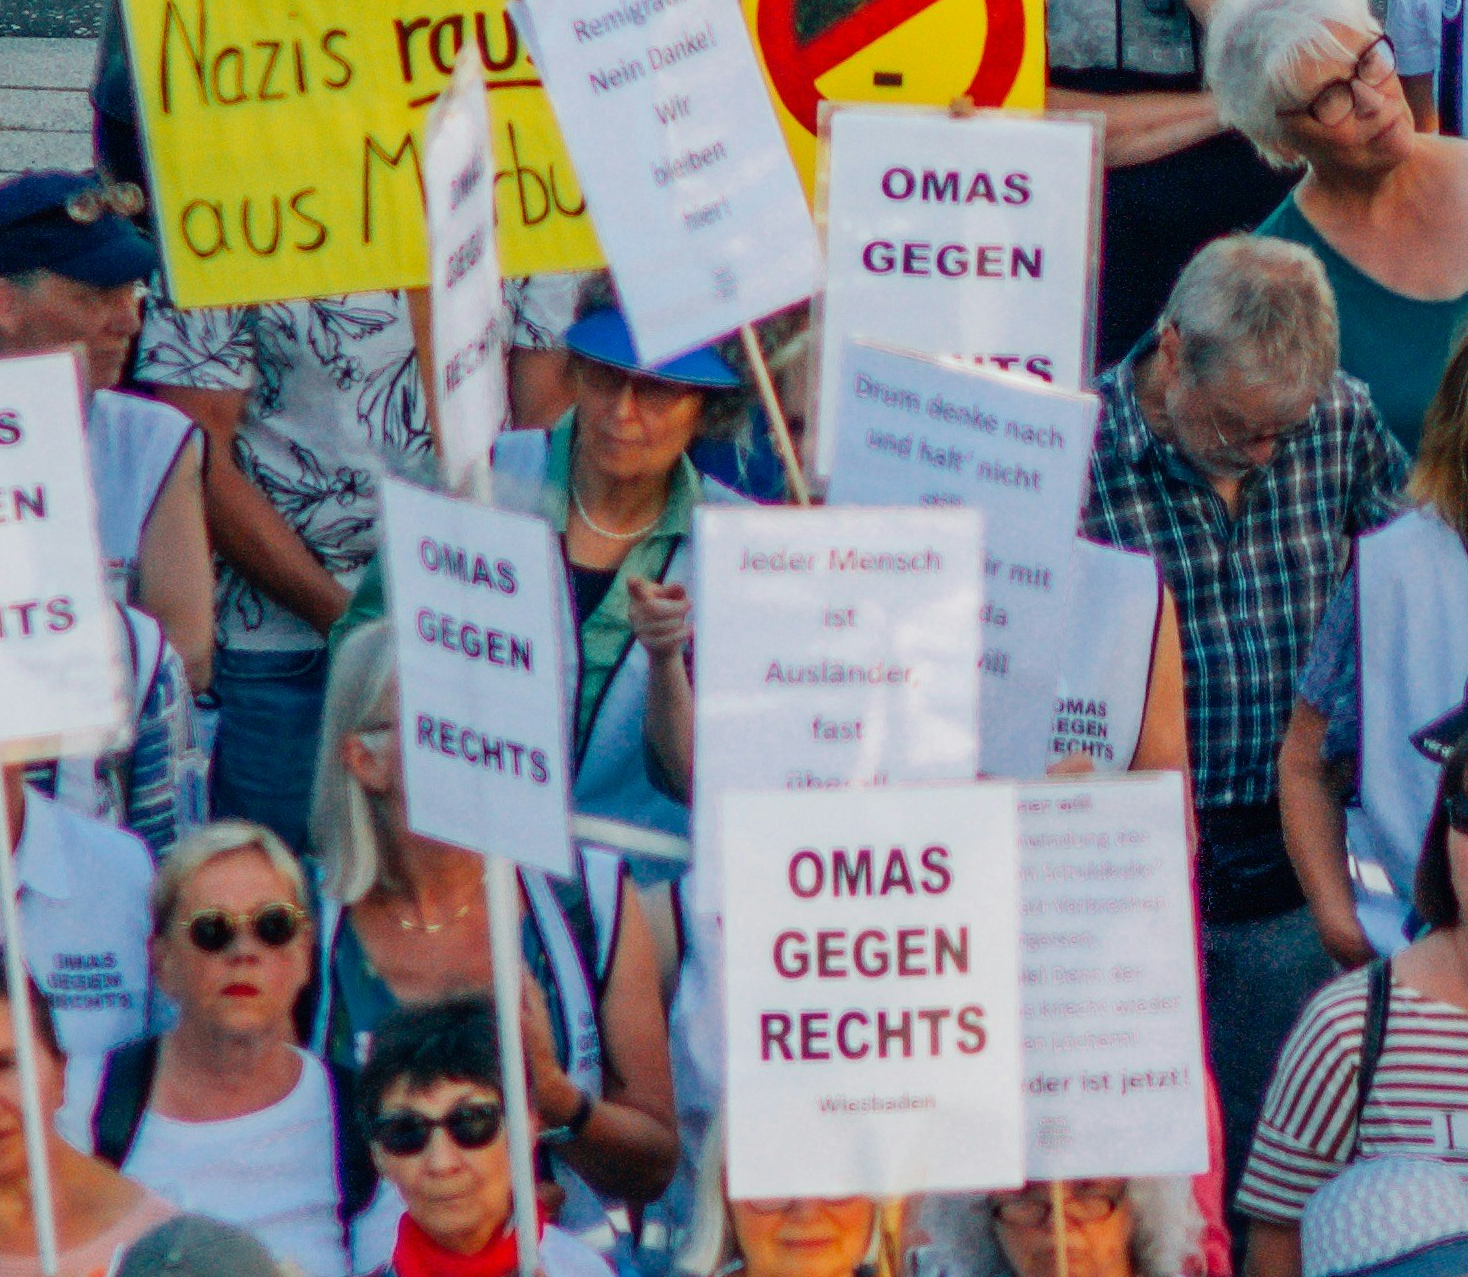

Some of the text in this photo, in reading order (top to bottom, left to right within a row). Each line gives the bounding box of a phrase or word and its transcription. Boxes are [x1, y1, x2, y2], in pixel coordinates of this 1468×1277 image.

[394, 9, 535, 83] rau
[588, 29, 719, 97] Nein Danke!
[654, 94, 692, 127] Wir
[652, 139, 726, 188] bleiben
[880, 165, 1033, 207] OMAS
[179, 185, 328, 258] aus
[861, 239, 1045, 280] GEGEN
[853, 372, 1066, 451] Drum denke nach
[866, 427, 1042, 491] und nicht
[418, 536, 517, 596] OMAS
[738, 547, 943, 574] Jeder Mensch
[415, 607, 534, 673] GEGEN
[823, 605, 855, 629] ist
[764, 658, 921, 688] Ausländer,
[415, 713, 550, 785] RECHTS
[810, 716, 865, 742] fast
[786, 844, 954, 901] OMAS
[771, 924, 971, 980] GEGEN
[758, 1005, 989, 1063] RECHTS
